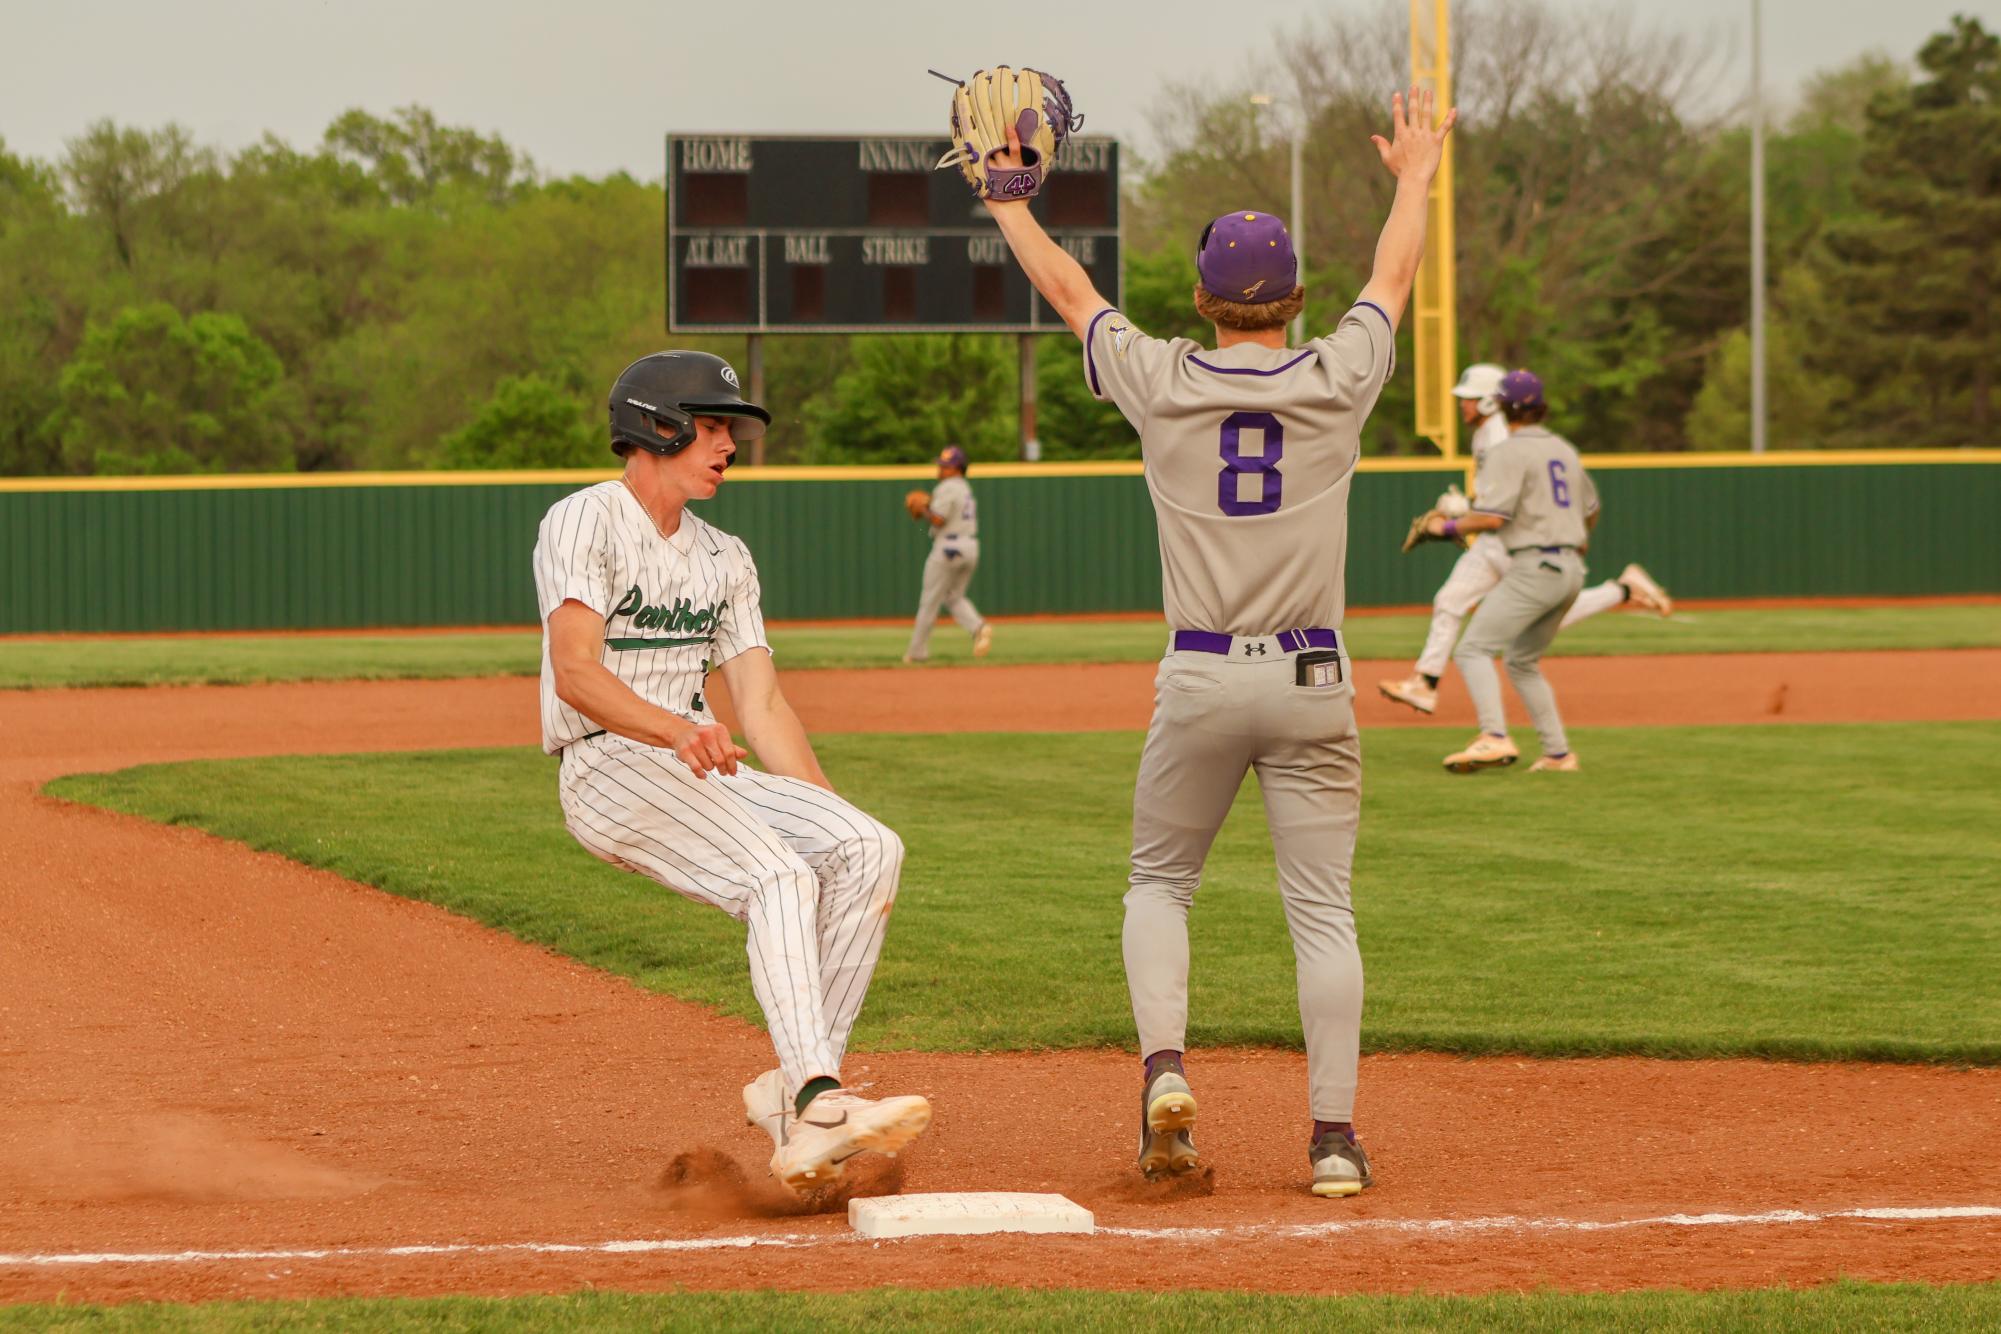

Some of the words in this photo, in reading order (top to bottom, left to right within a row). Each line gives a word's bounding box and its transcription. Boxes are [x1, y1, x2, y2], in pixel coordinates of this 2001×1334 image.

[683, 140, 753, 171] HOME
[859, 140, 936, 171] INNING
[685, 236, 709, 265] AT
[713, 236, 748, 265] BAT
[785, 236, 831, 264] BALL
[862, 236, 930, 265] STRIKE
[968, 236, 1008, 265] OUT
[1218, 411, 1284, 517] 8
[1547, 459, 1570, 508] 6
